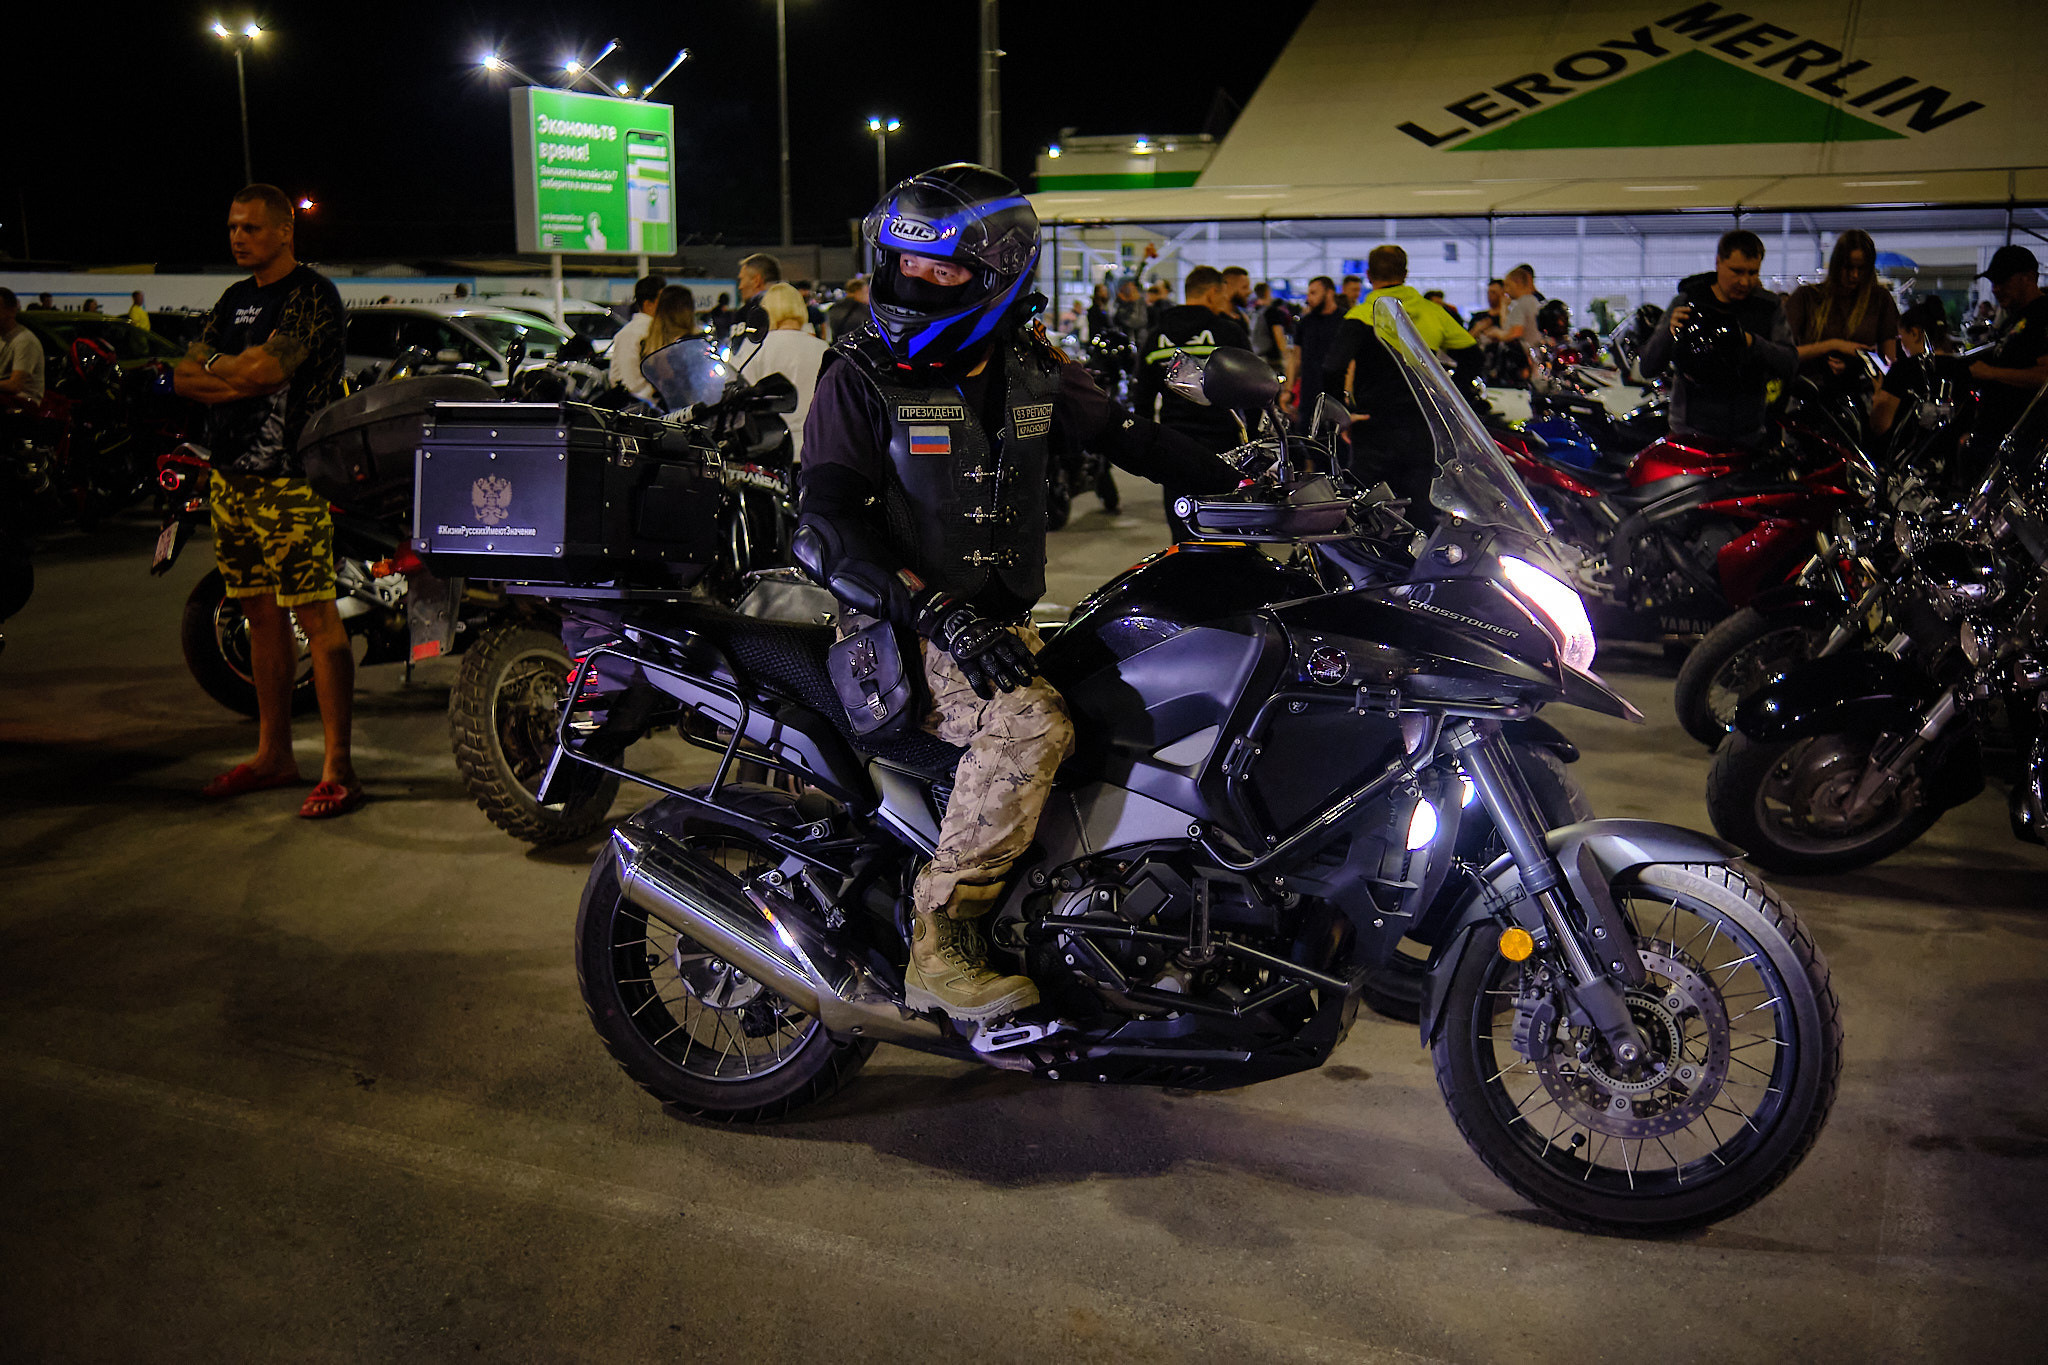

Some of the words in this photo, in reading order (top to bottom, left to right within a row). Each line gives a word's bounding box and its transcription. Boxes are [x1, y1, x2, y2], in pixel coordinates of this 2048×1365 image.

[1395, 25, 1672, 148] LEROY
[1655, 2, 1986, 133] MERLIN
[537, 114, 617, 142] Экономьте
[539, 142, 590, 164] время!
[893, 222, 936, 239] HJC
[902, 408, 960, 419] ПРЕЗИДЕНТ
[1016, 409, 1026, 419] 93
[1026, 406, 1051, 418] РЕГИОН
[1407, 599, 1520, 639] CROSSTOURER
[1660, 617, 1711, 633] YAMAH
